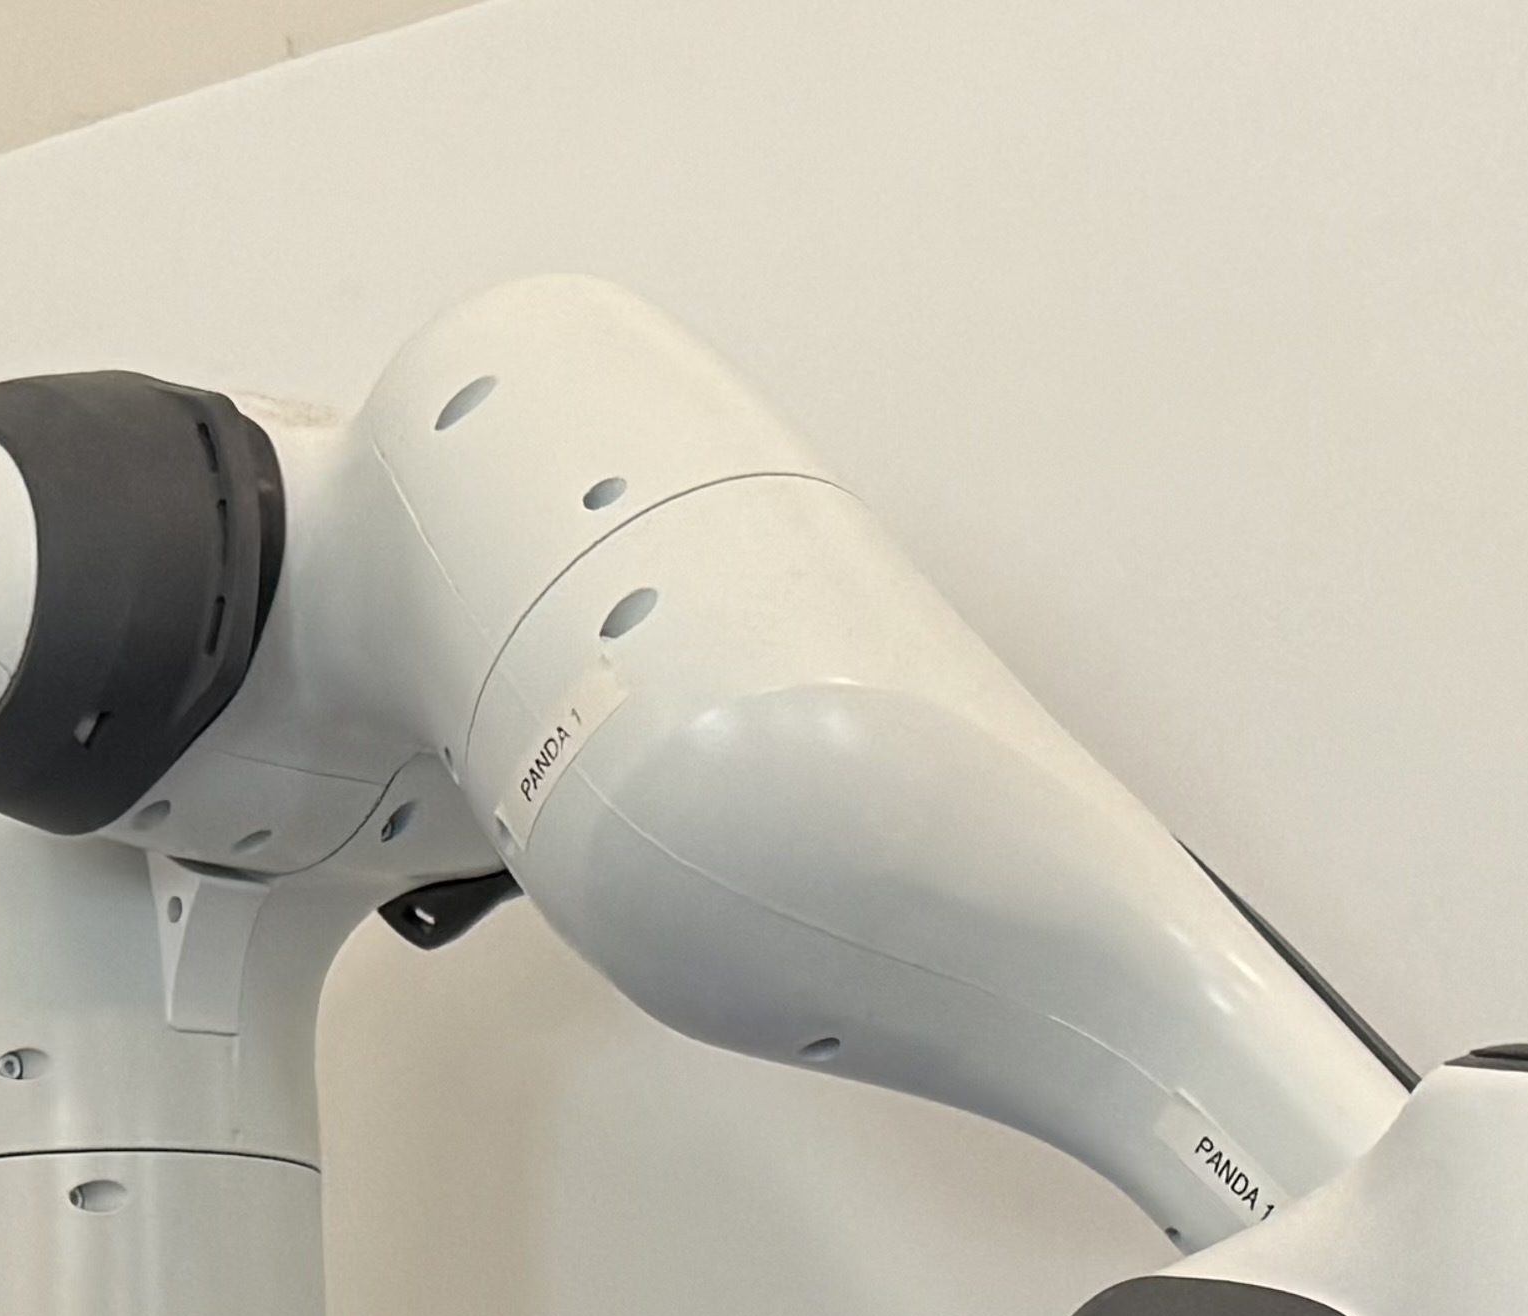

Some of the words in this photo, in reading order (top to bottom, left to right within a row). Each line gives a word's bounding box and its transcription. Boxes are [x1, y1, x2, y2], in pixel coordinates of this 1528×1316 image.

[521, 726, 570, 801] PANDA
[571, 708, 582, 726] 1
[1194, 1136, 1259, 1211] PANDA
[1260, 1204, 1275, 1222] 1
